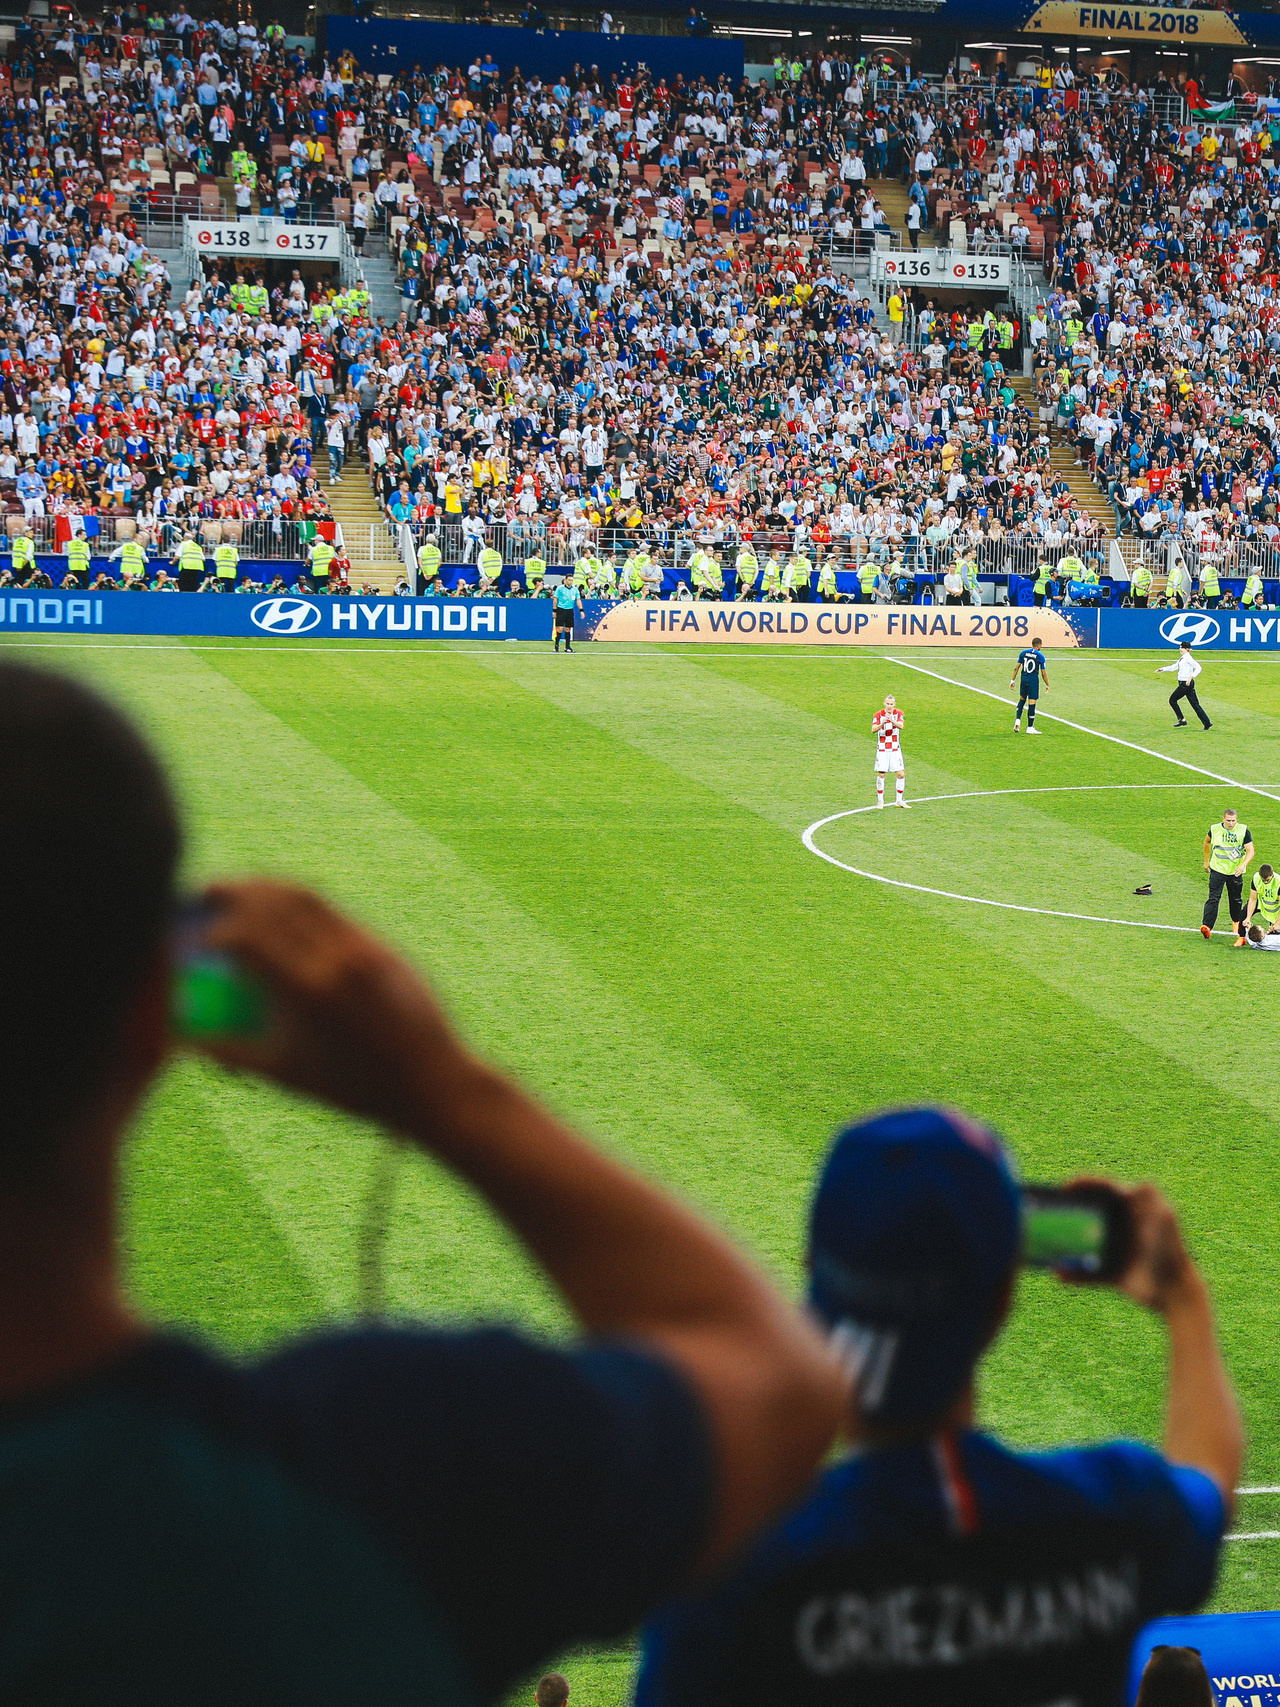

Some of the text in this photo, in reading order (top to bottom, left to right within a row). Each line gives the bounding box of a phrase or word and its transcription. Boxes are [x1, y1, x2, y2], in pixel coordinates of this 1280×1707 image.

[1080, 8, 1199, 34] FINAL 2018
[214, 230, 250, 247] 138
[293, 234, 328, 250] 137
[898, 260, 931, 276] 136
[968, 263, 1000, 279] 135
[332, 603, 507, 632] HYUNDAI
[645, 609, 700, 632] FIFA
[708, 610, 809, 633] WORLD
[887, 613, 962, 636] FINAL
[969, 615, 1029, 637] 2018
[1023, 657, 1036, 674] 10
